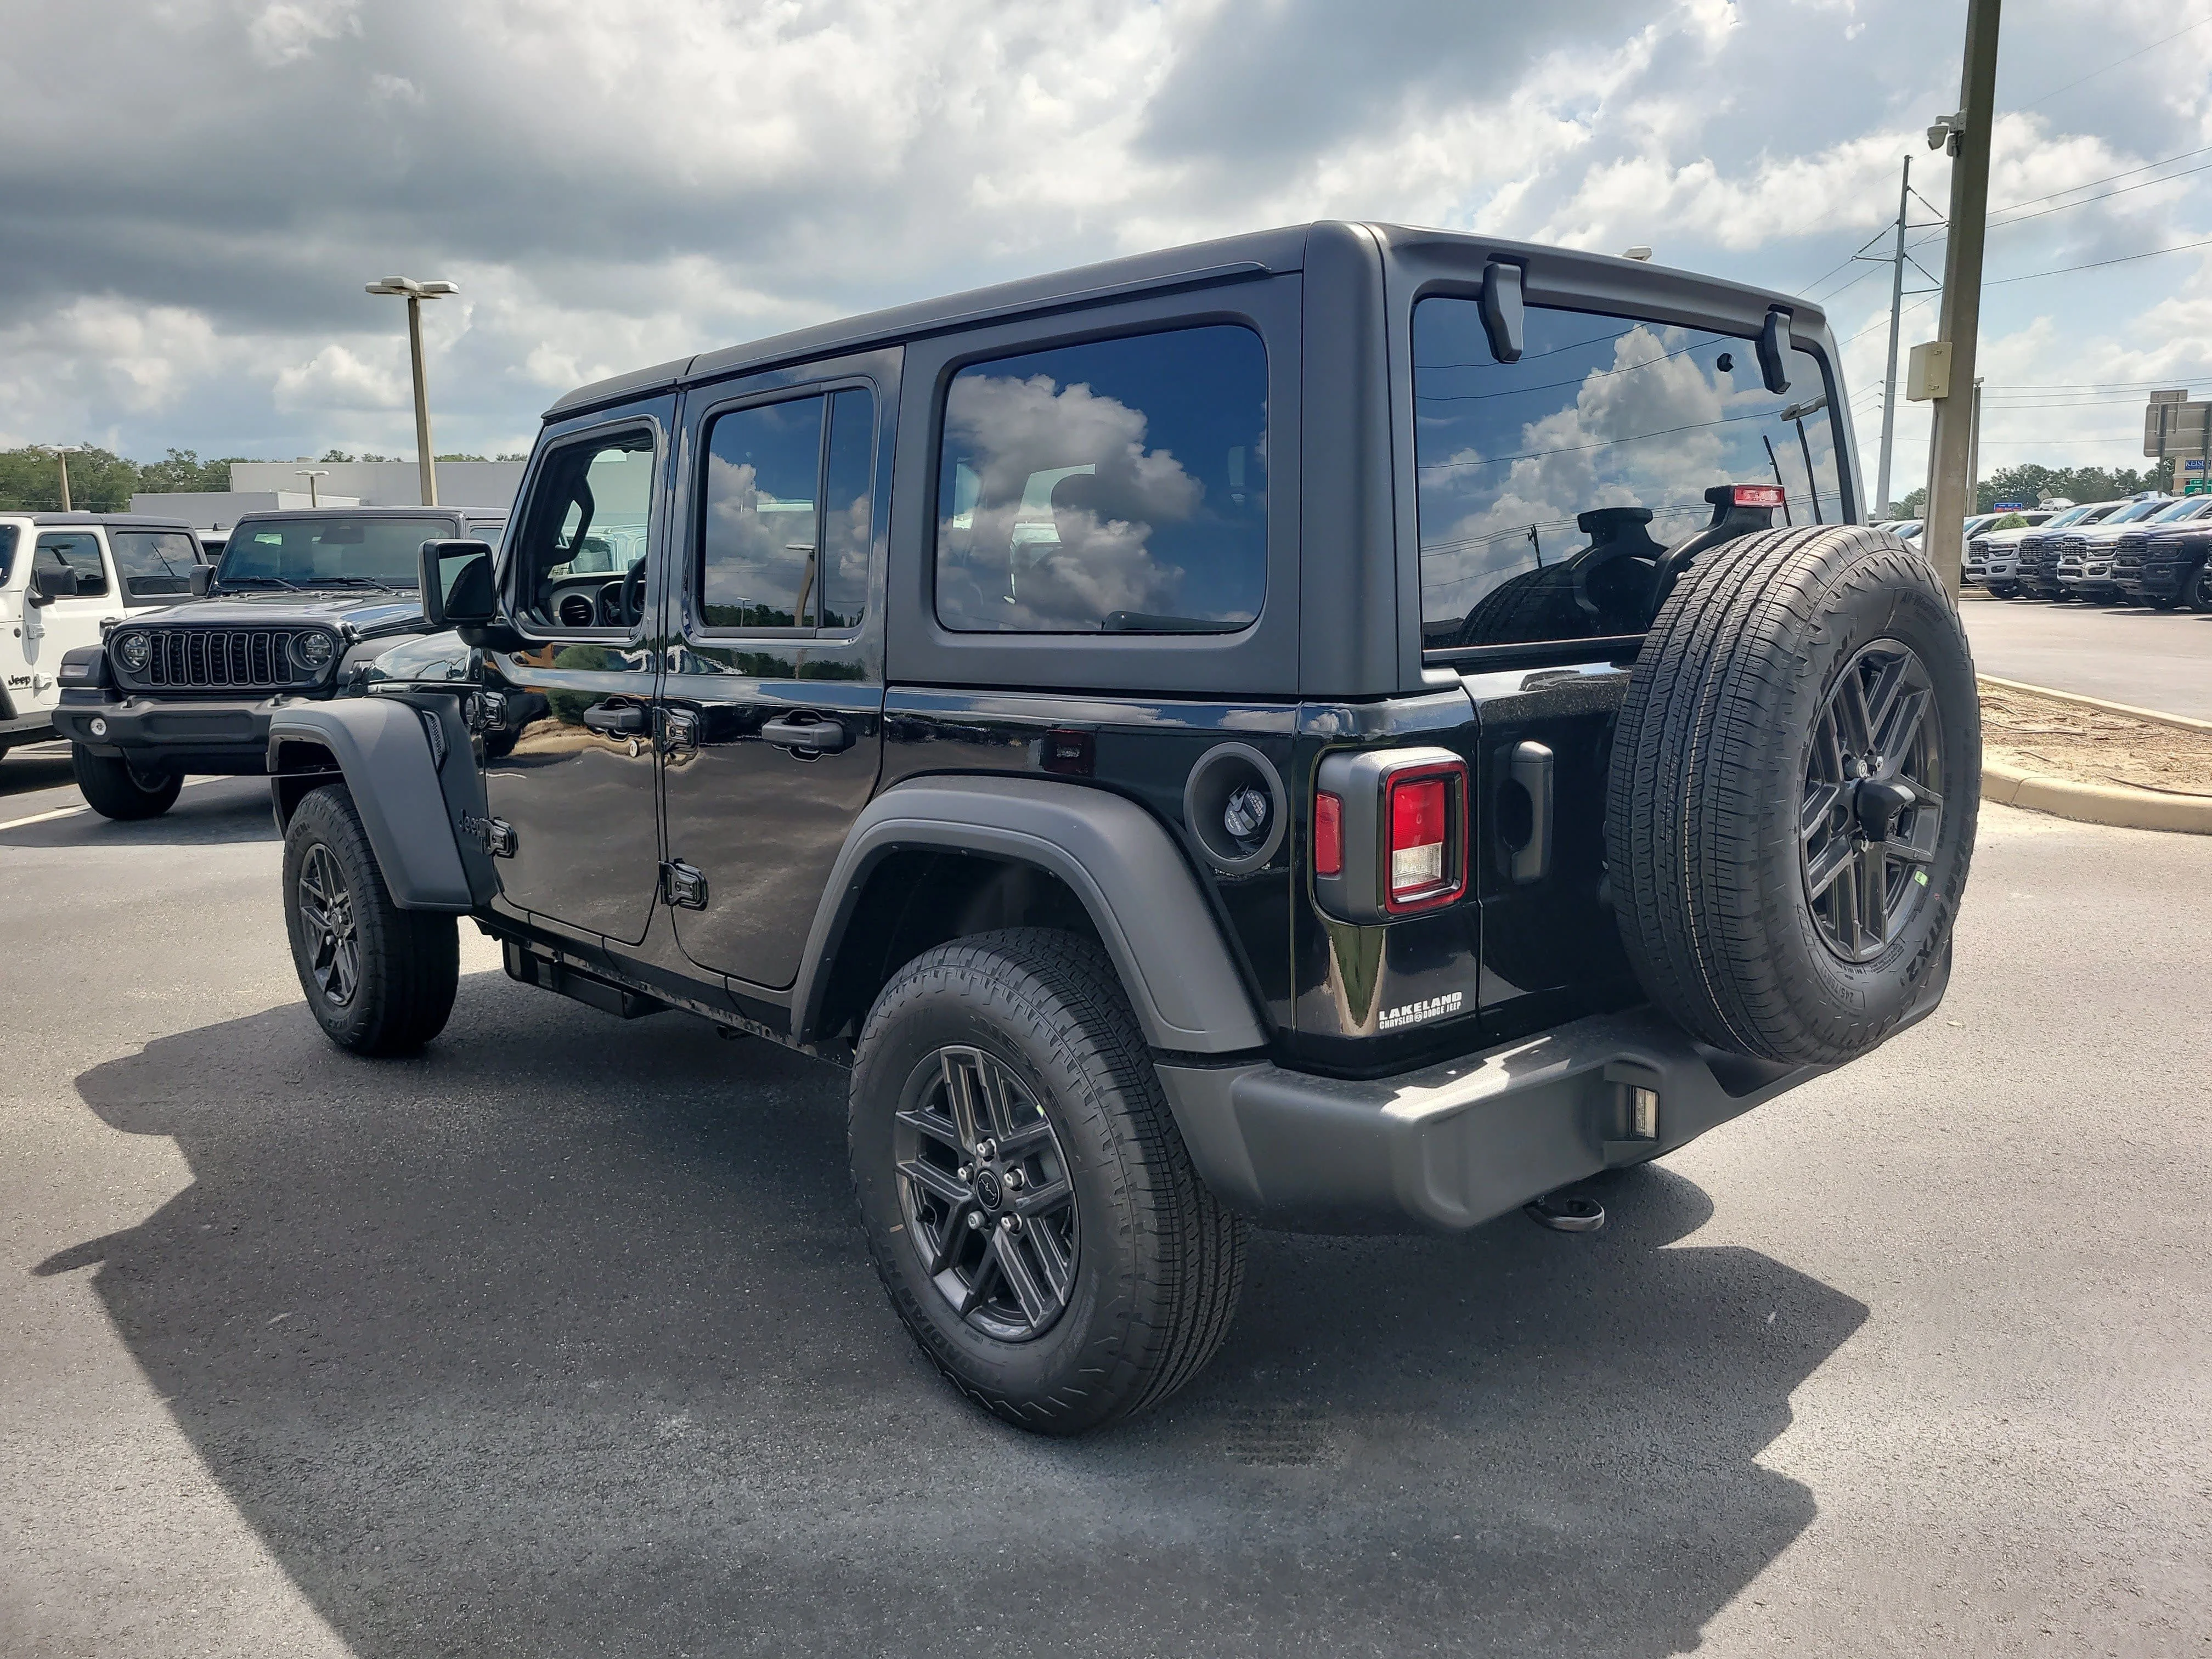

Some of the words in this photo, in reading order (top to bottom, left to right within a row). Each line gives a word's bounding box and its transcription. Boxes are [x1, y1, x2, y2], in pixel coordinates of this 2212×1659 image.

[8, 675, 31, 686] Jeep
[1379, 991, 1462, 1020] LAKELAND
[1379, 1014, 1414, 1029] CHRYSLER
[1423, 1007, 1444, 1019] DODGE
[1446, 1001, 1462, 1012] JEEP
